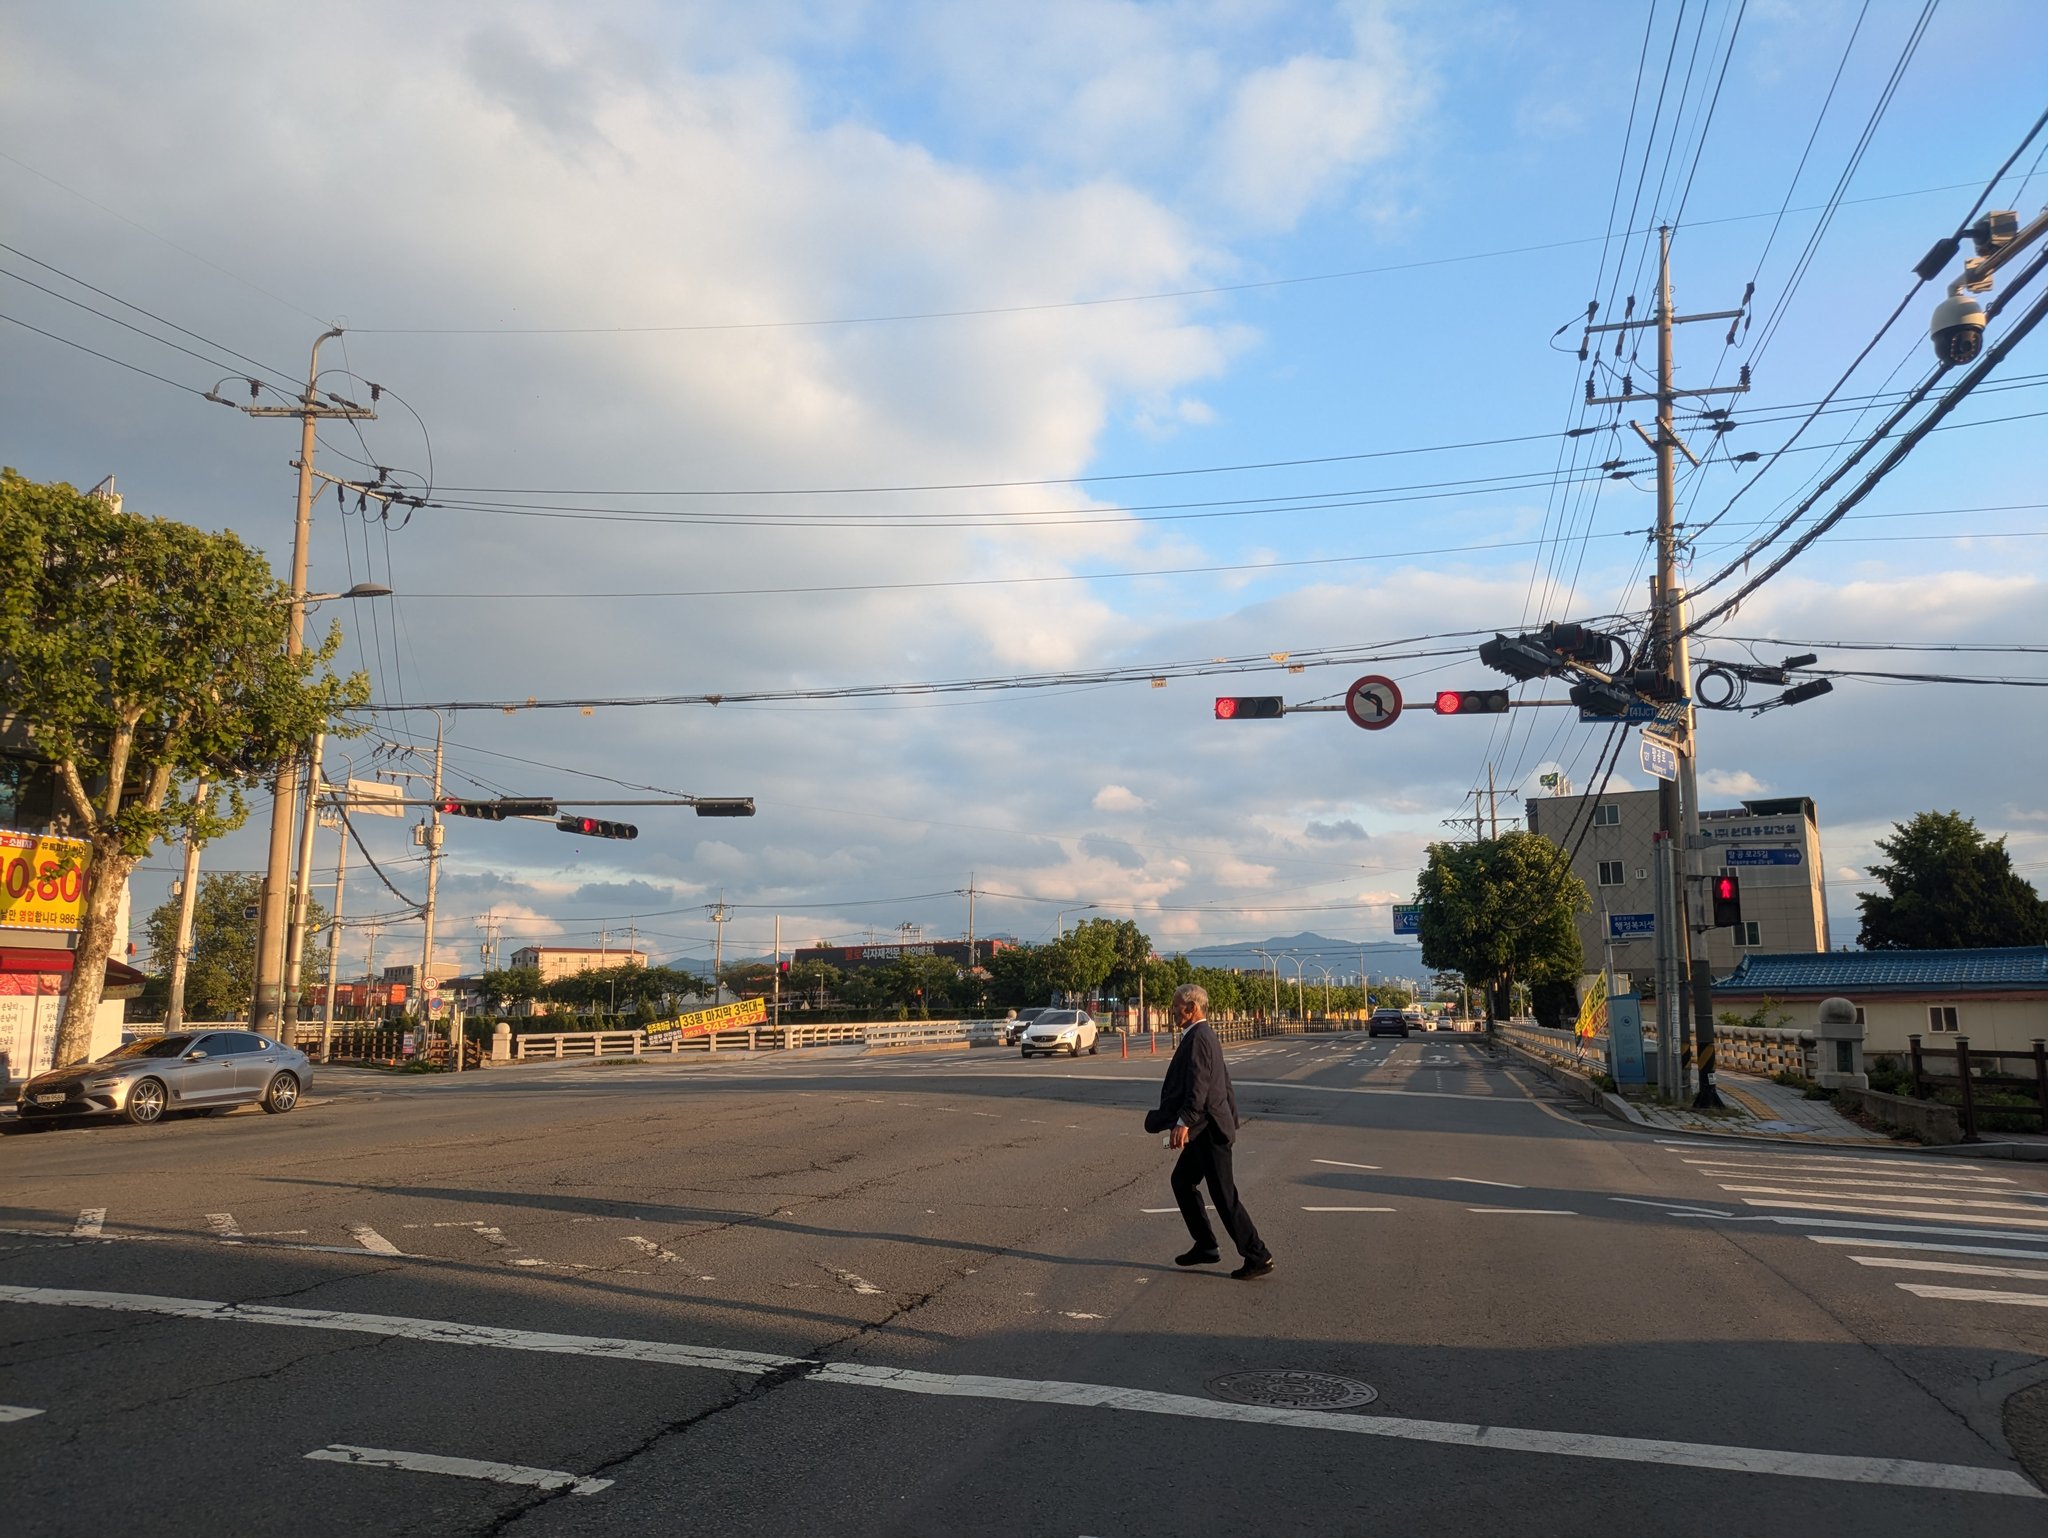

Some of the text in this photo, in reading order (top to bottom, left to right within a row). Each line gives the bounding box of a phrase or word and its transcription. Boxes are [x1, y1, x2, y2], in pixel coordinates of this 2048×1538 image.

[1727, 850, 1769, 859] 팔공로25길
[19, 910, 57, 924] 영업합니다
[862, 947, 899, 960] 식자재전문
[682, 1013, 703, 1027] 33평
[706, 1008, 731, 1021] 마지막
[703, 1013, 765, 1033] 945-6827
